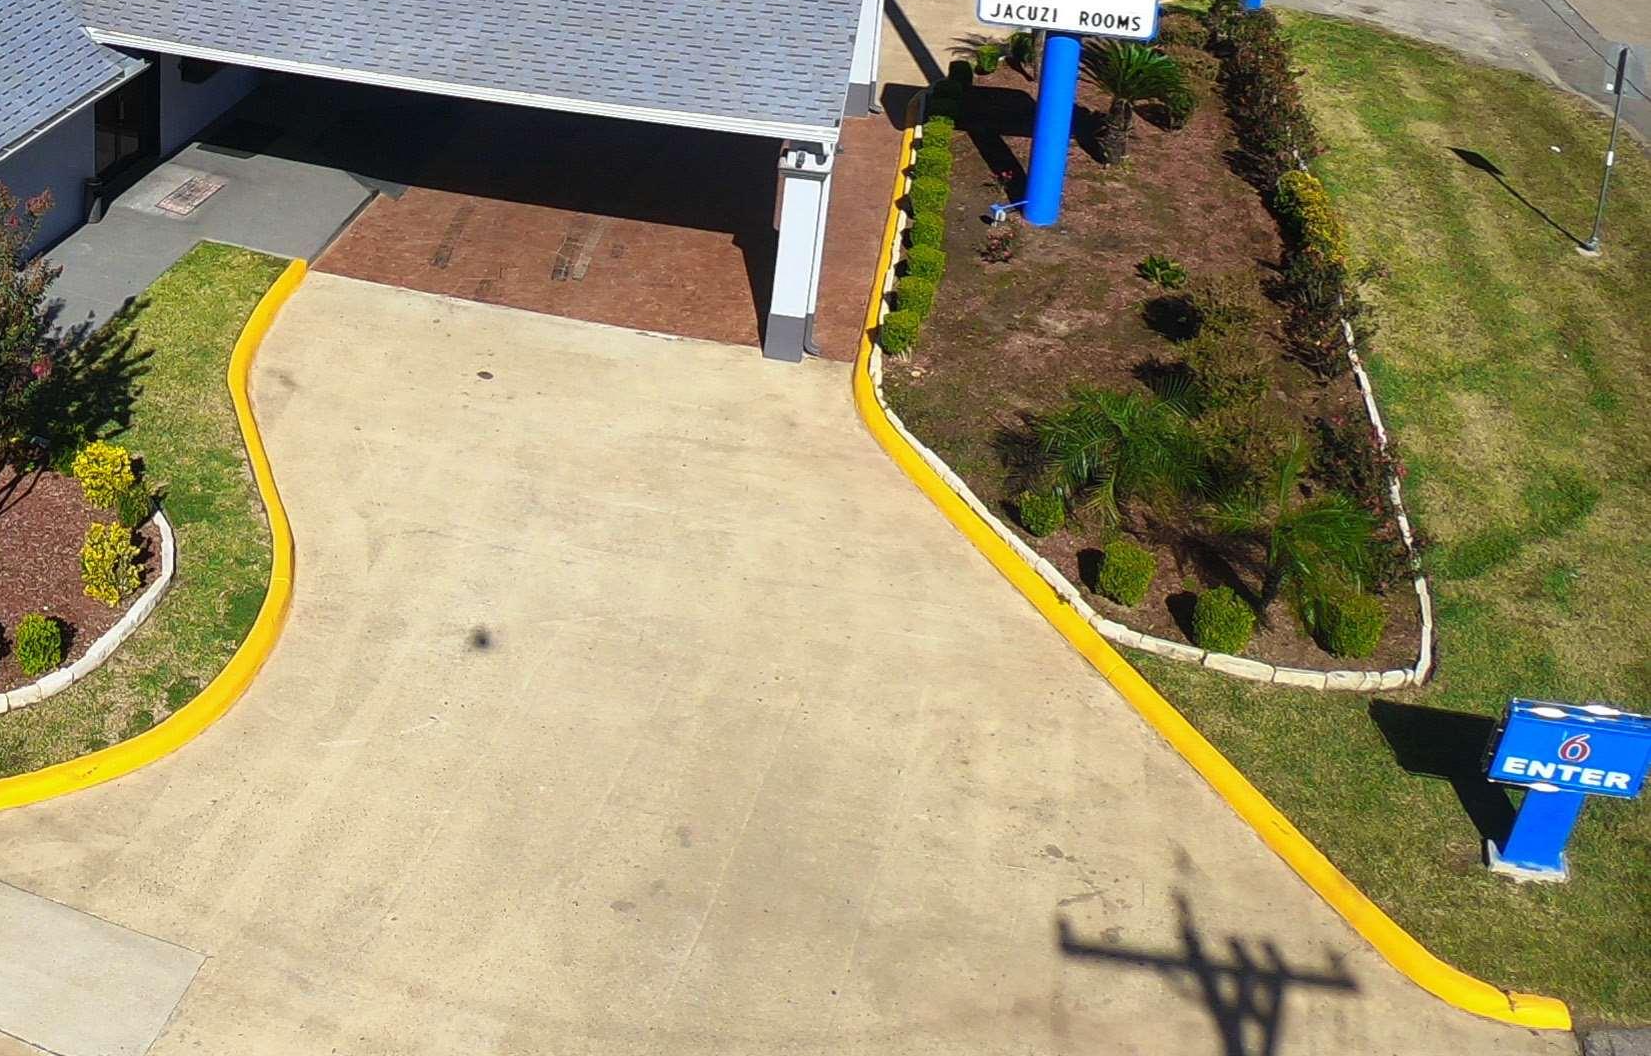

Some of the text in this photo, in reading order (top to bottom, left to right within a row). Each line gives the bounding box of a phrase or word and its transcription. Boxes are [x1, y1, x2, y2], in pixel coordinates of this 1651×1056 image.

[990, 3, 1141, 32] JACUZI ROOMS
[1558, 733, 1591, 763] 6
[1502, 755, 1632, 790] ENTER
